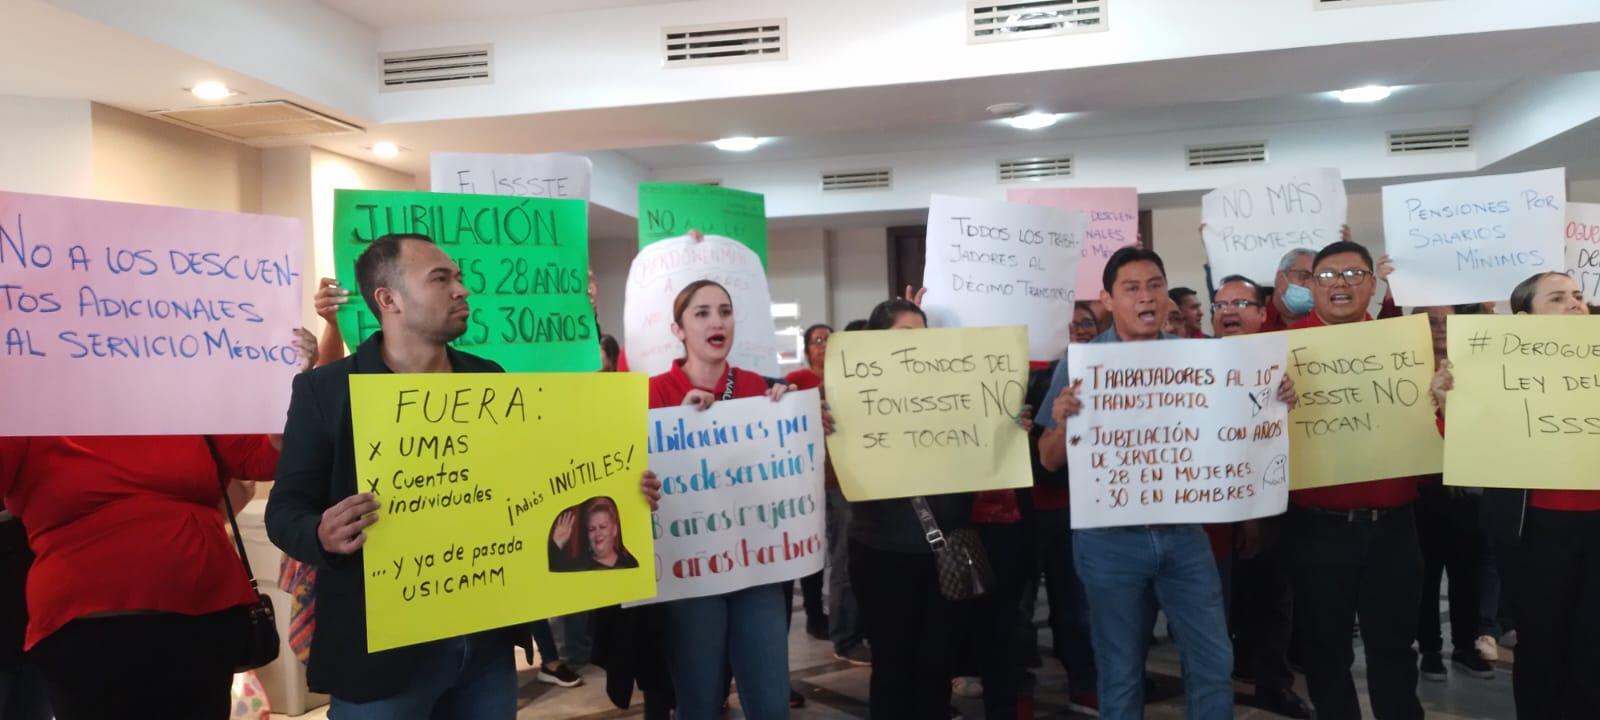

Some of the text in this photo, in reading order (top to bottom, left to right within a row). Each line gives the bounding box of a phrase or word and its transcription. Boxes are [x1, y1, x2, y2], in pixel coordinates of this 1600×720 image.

[1222, 175, 1322, 219] NO MÁS
[1405, 189, 1559, 222] PENSIONES POR
[352, 199, 559, 247] JUBILACIÓN
[646, 208, 676, 231] NO
[951, 216, 1011, 241] TODOS
[1019, 229, 1044, 245] LOS
[0, 213, 299, 286] NO A LOS DESCUEN-
[1408, 225, 1507, 249] SALARIOS
[950, 244, 1046, 271] JADORES AL
[495, 258, 529, 295] 28
[535, 263, 582, 295] AÑOS
[0, 284, 264, 323] TOS ADICIONALES
[499, 306, 535, 343] 30
[536, 312, 591, 342] AÑOS
[6, 327, 46, 357] AL
[59, 331, 199, 359] SERVICIO
[1502, 333, 1600, 359] DEROGUE
[841, 347, 1019, 378] LOS FONDOS DEL
[1088, 364, 1216, 390] TRABAJADORES
[1226, 368, 1244, 387] AL
[1291, 347, 1425, 377] FONDOS DEL
[1296, 378, 1419, 408] ISSSTE NO
[1502, 363, 1600, 394] LEY DEL
[396, 387, 543, 425] FUERA:
[858, 379, 1025, 420] FOVISSSTE NO
[399, 434, 470, 460] UMAS
[863, 432, 889, 449] SE
[1090, 419, 1283, 449] JUBILACIÓN CON AÑOS
[549, 444, 635, 496] INÚTILES!
[1091, 452, 1107, 469] DE
[392, 463, 470, 490] Cuentas
[1108, 470, 1130, 485] 28
[1140, 468, 1163, 482] EN
[388, 486, 493, 515] individuales
[1108, 490, 1129, 508] 30
[1140, 490, 1164, 505] EN
[414, 553, 435, 577] ya
[443, 544, 465, 564] de
[472, 536, 523, 566] pasada
[402, 566, 506, 602] USICAMM
